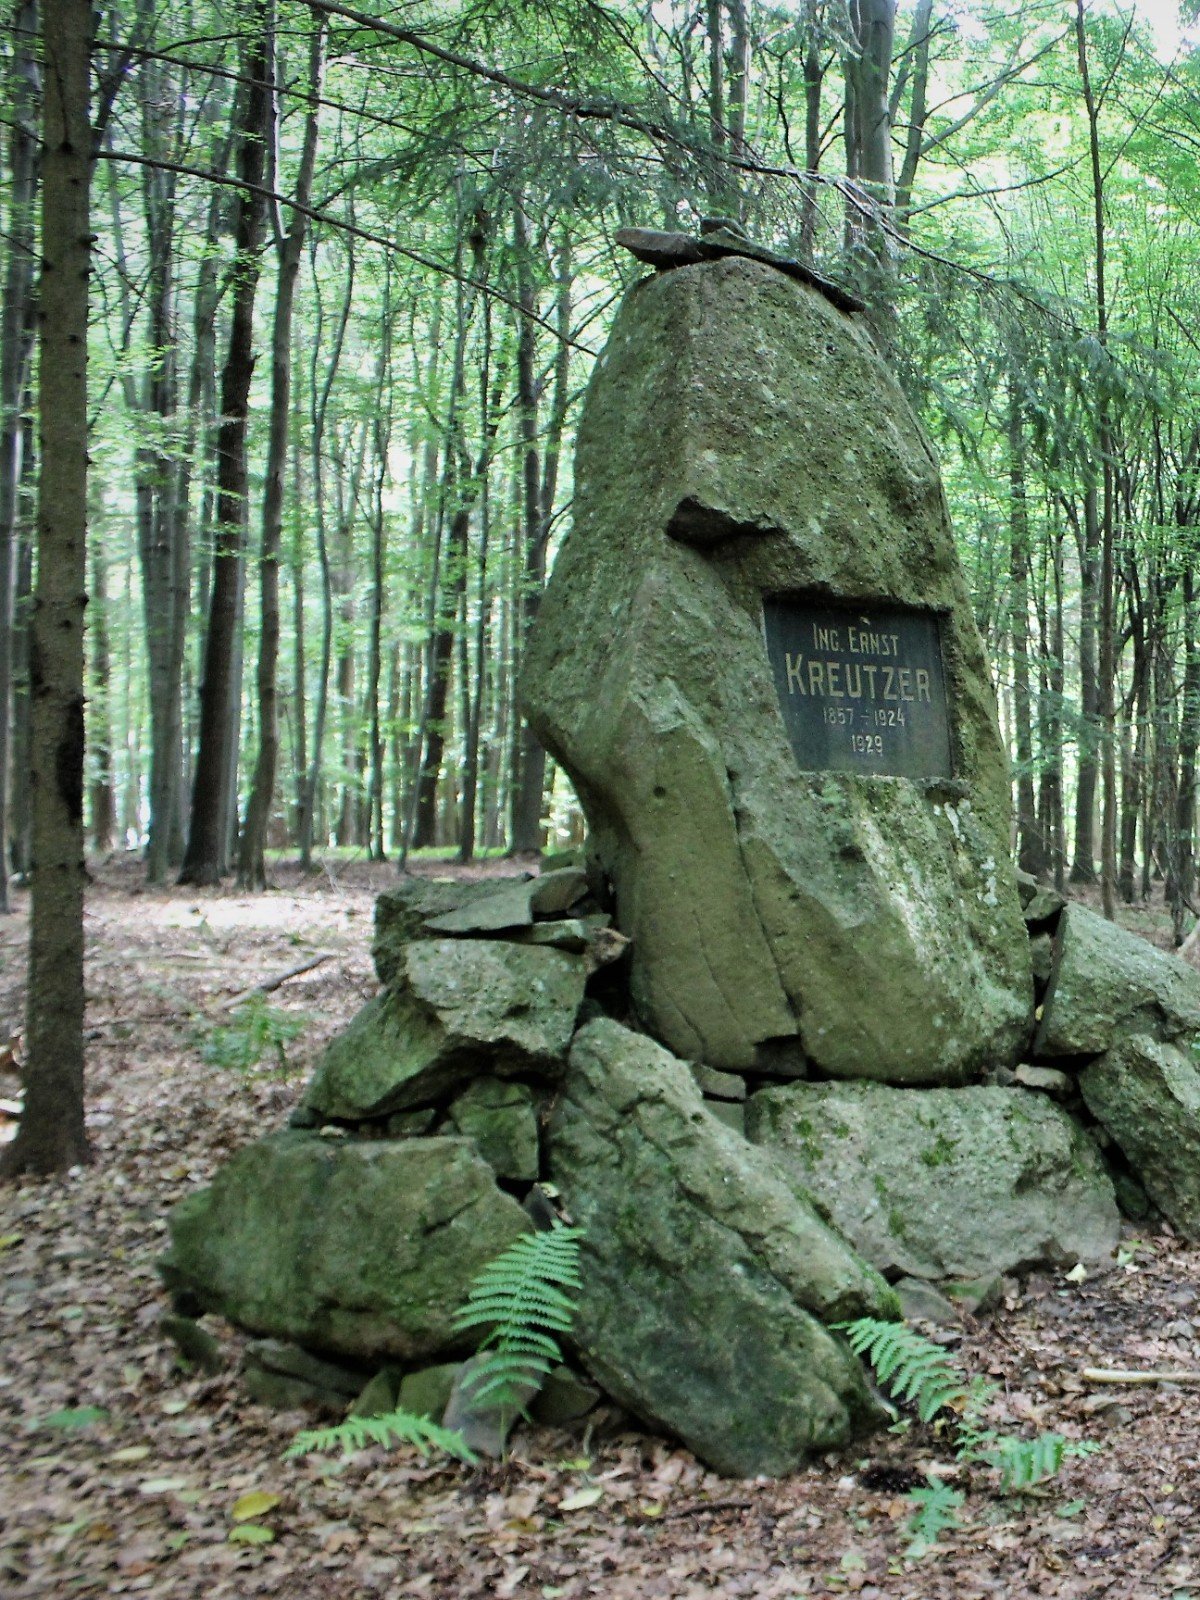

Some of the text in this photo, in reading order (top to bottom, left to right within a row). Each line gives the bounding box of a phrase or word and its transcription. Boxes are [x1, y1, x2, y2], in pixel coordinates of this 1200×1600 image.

[785, 652, 931, 702] KREUTZER
[823, 707, 854, 725] 1857
[874, 707, 906, 726] 1924
[851, 735, 883, 756] 1929
